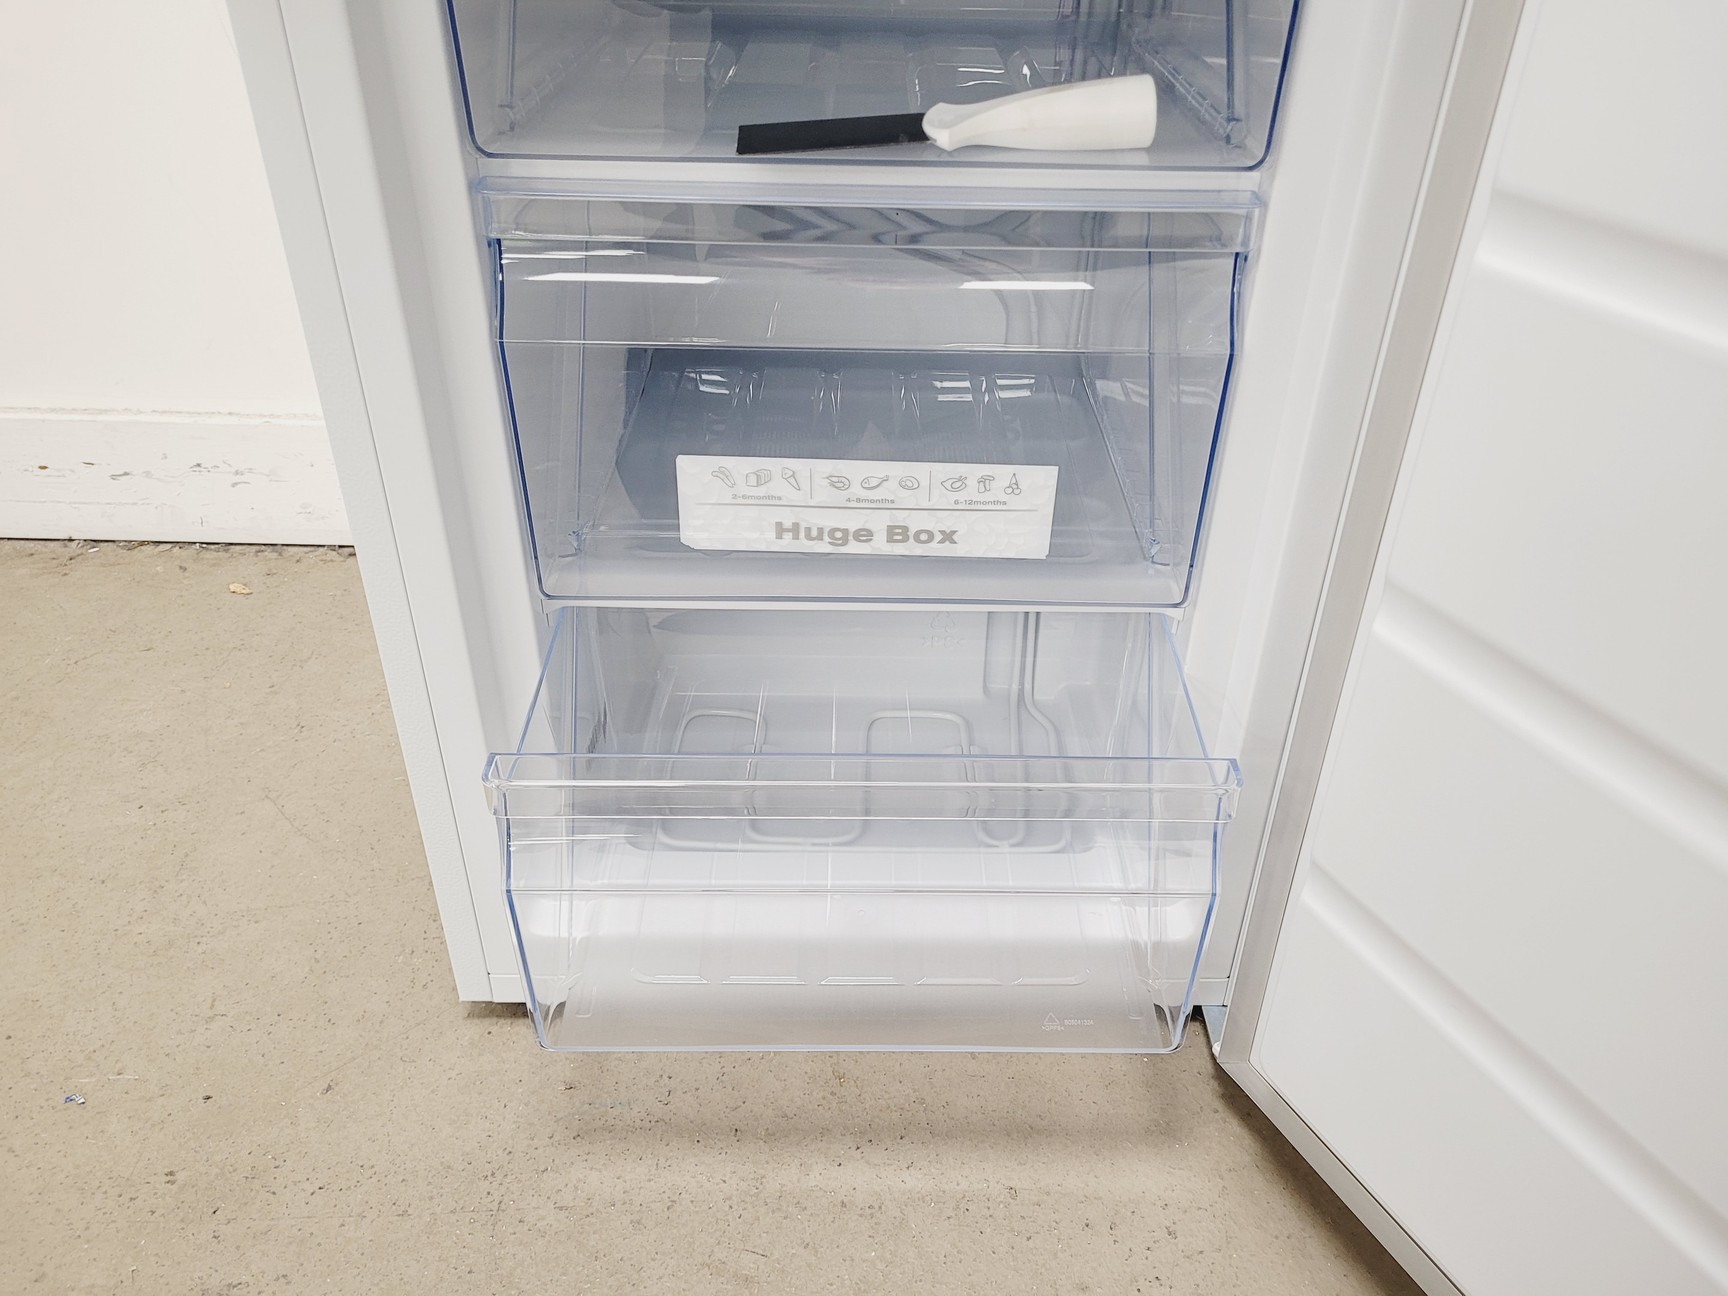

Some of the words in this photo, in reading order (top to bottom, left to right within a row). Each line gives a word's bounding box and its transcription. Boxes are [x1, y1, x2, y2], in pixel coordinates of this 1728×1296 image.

[731, 492, 783, 502] 2-6months
[845, 497, 896, 506] 4-8months
[953, 498, 1008, 507] 6-12months
[774, 521, 874, 547] Huge
[885, 524, 959, 546] Box
